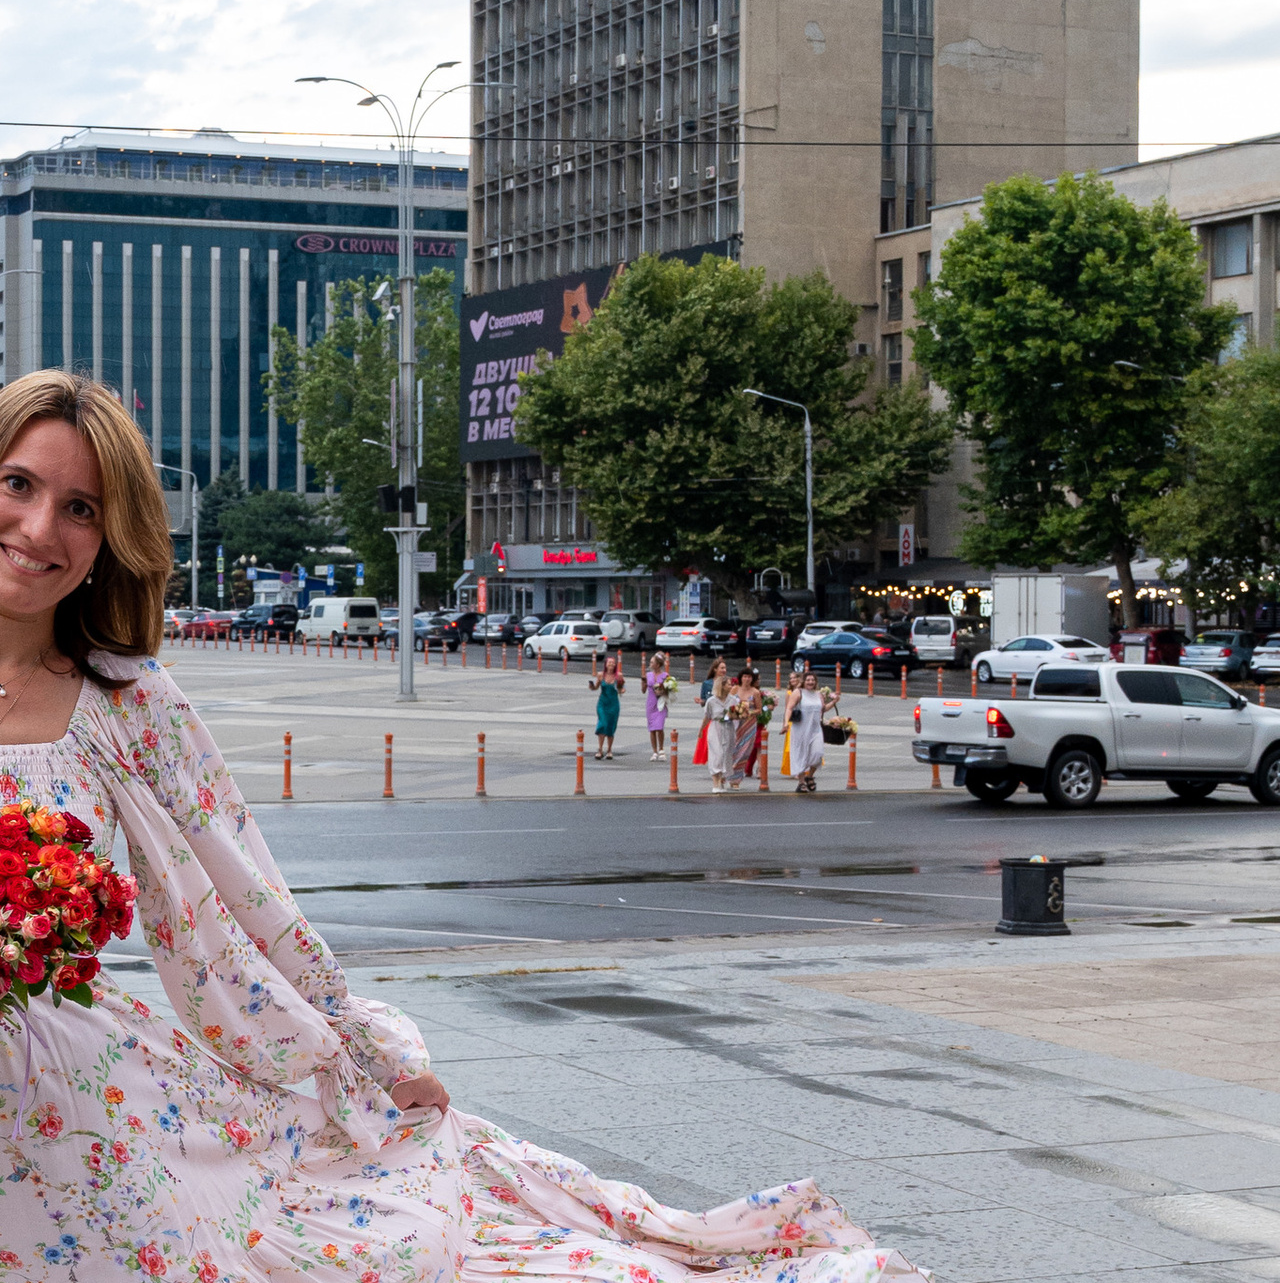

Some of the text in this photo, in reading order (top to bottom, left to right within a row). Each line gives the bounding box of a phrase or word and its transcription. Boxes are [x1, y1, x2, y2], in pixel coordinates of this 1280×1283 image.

[488, 308, 544, 331] Светлоград
[472, 351, 553, 386] ДВУШК
[468, 388, 492, 417] 12
[467, 421, 479, 443] В
